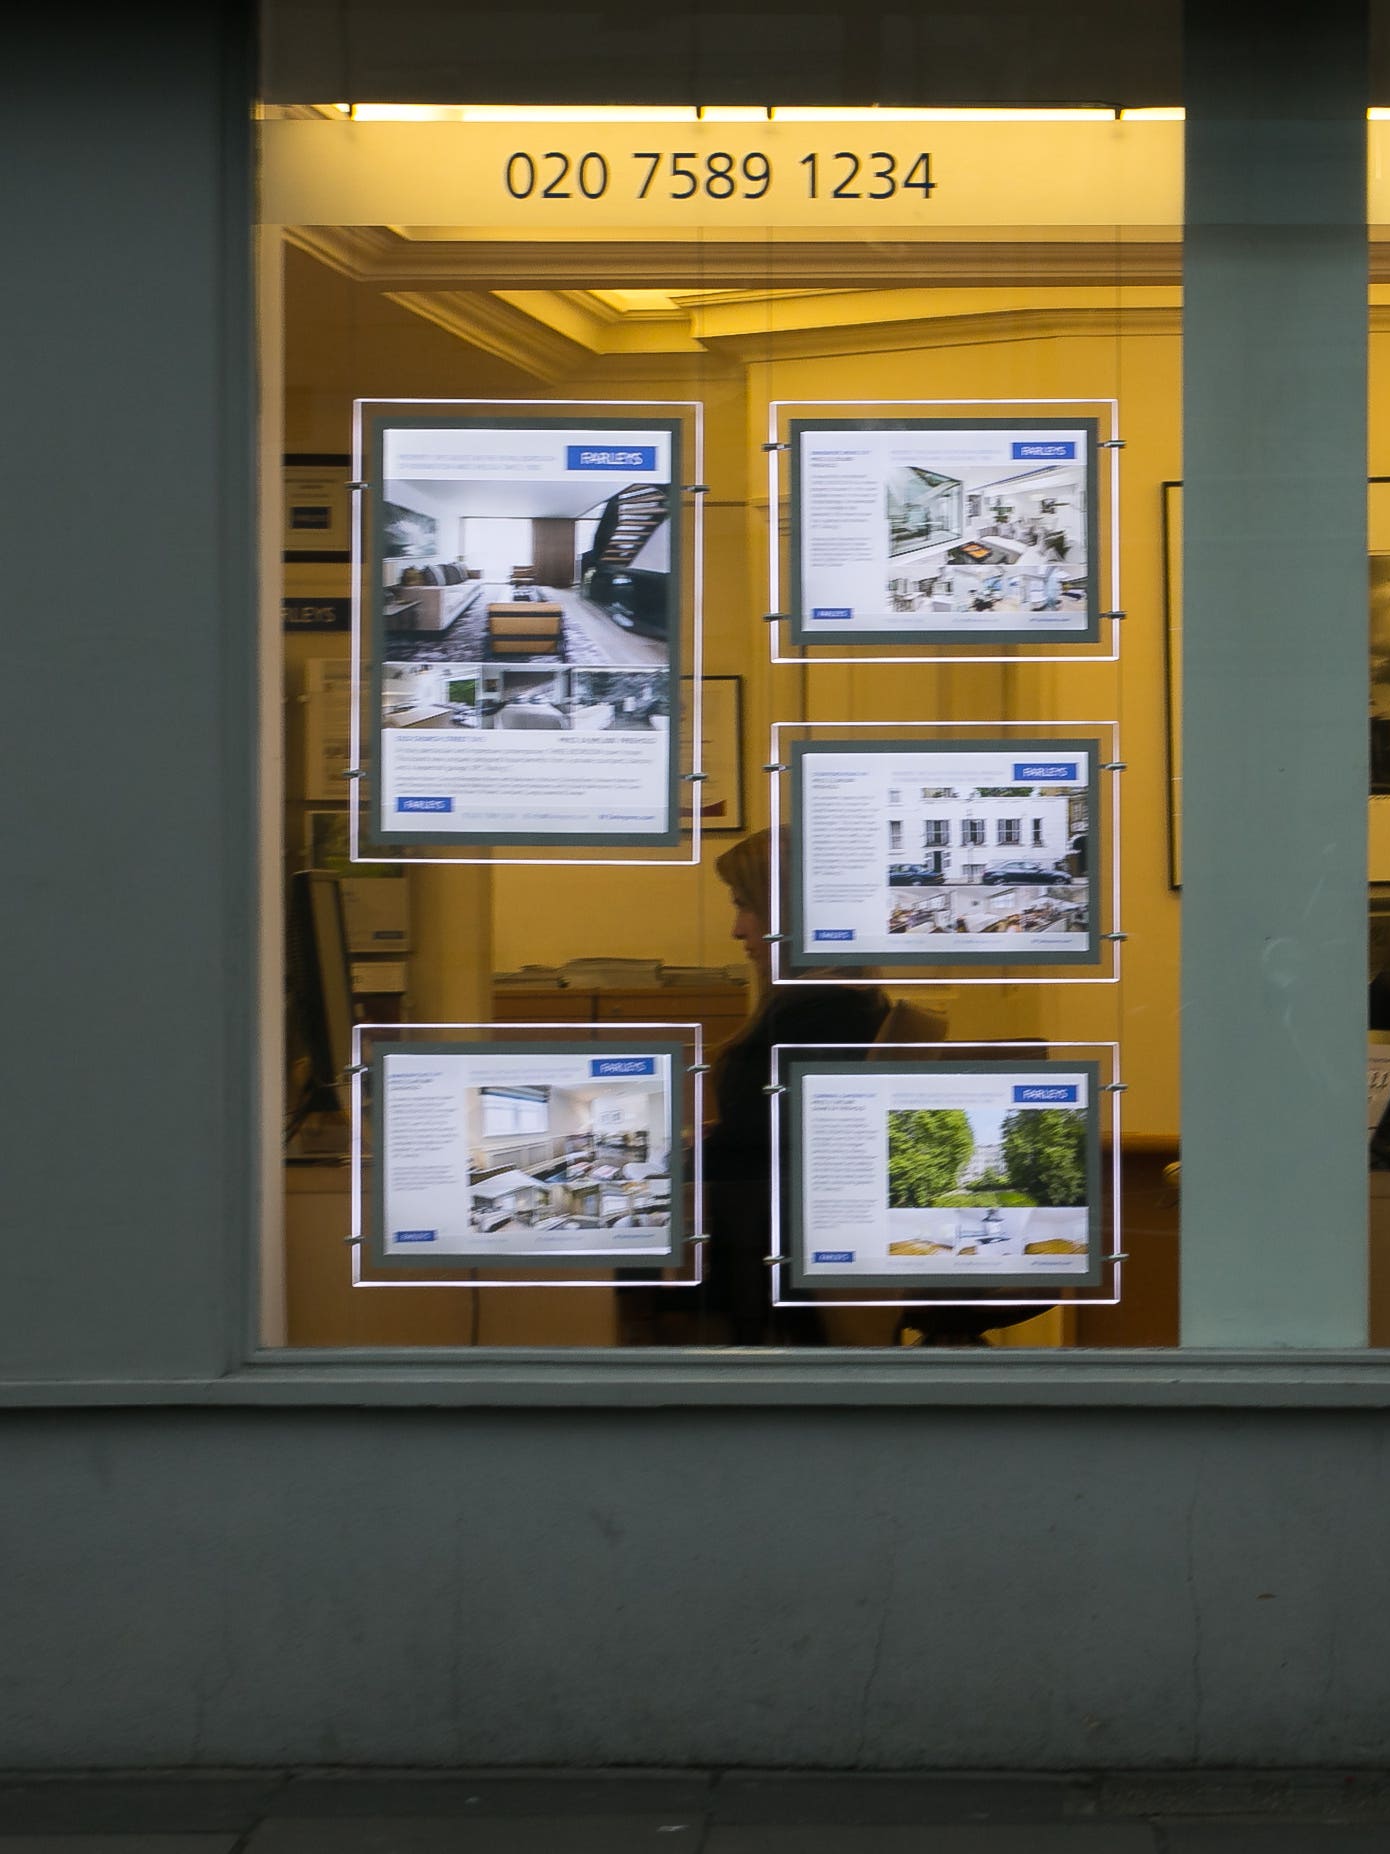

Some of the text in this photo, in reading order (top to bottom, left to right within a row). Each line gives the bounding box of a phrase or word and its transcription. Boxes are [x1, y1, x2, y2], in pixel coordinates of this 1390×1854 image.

[506, 151, 937, 200] 020 7589 1234
[1022, 445, 1067, 456] FARLEYS
[580, 451, 644, 465] FARLEYS
[1022, 767, 1069, 777] FARLEYS
[600, 1061, 648, 1074] FARLEYS
[1022, 1089, 1069, 1099] FARLEYS
